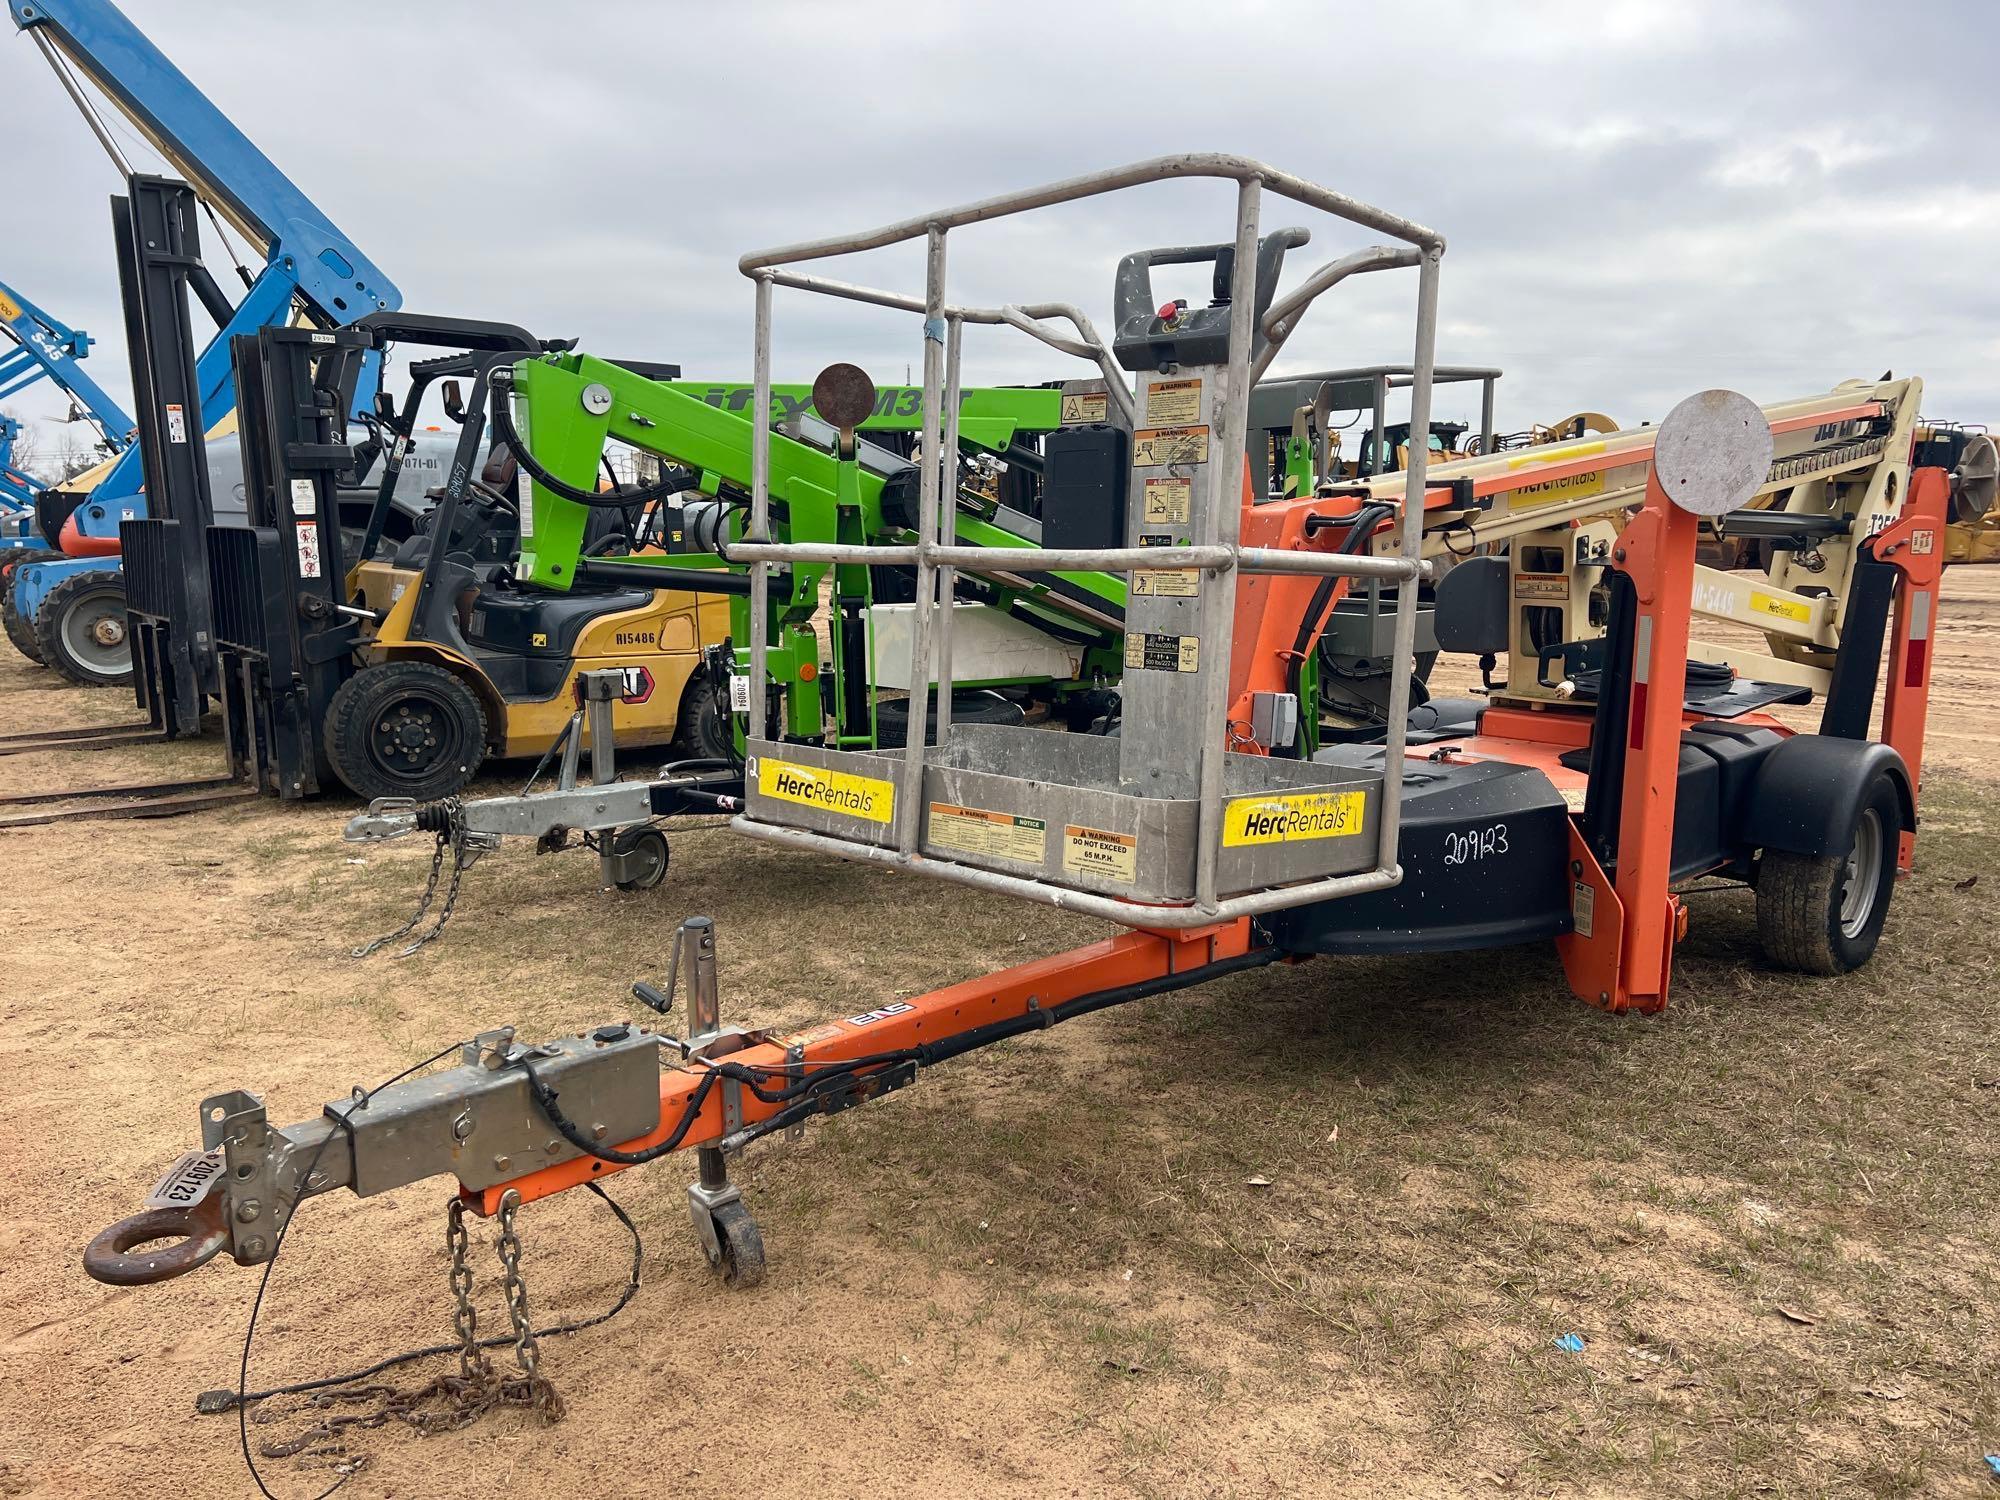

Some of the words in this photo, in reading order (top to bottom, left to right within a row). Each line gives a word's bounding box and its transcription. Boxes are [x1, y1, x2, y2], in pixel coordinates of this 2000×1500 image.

[31, 332, 64, 360] S-45
[1164, 381, 1192, 390] WARNING
[775, 773, 874, 813] HercRentals
[964, 810, 989, 820] WARNING
[1019, 819, 1040, 828] NOTICE
[1244, 806, 1347, 837] HercRentals
[1072, 837, 1083, 846] DO
[1084, 839, 1099, 848] NOT
[1099, 842, 1127, 854] EXCEED
[1088, 831, 1121, 844] WARNING
[1444, 823, 1509, 865] 209123
[1084, 850, 1093, 859] 65
[1093, 852, 1114, 863] M.P.H.
[168, 1160, 220, 1202] 209123
